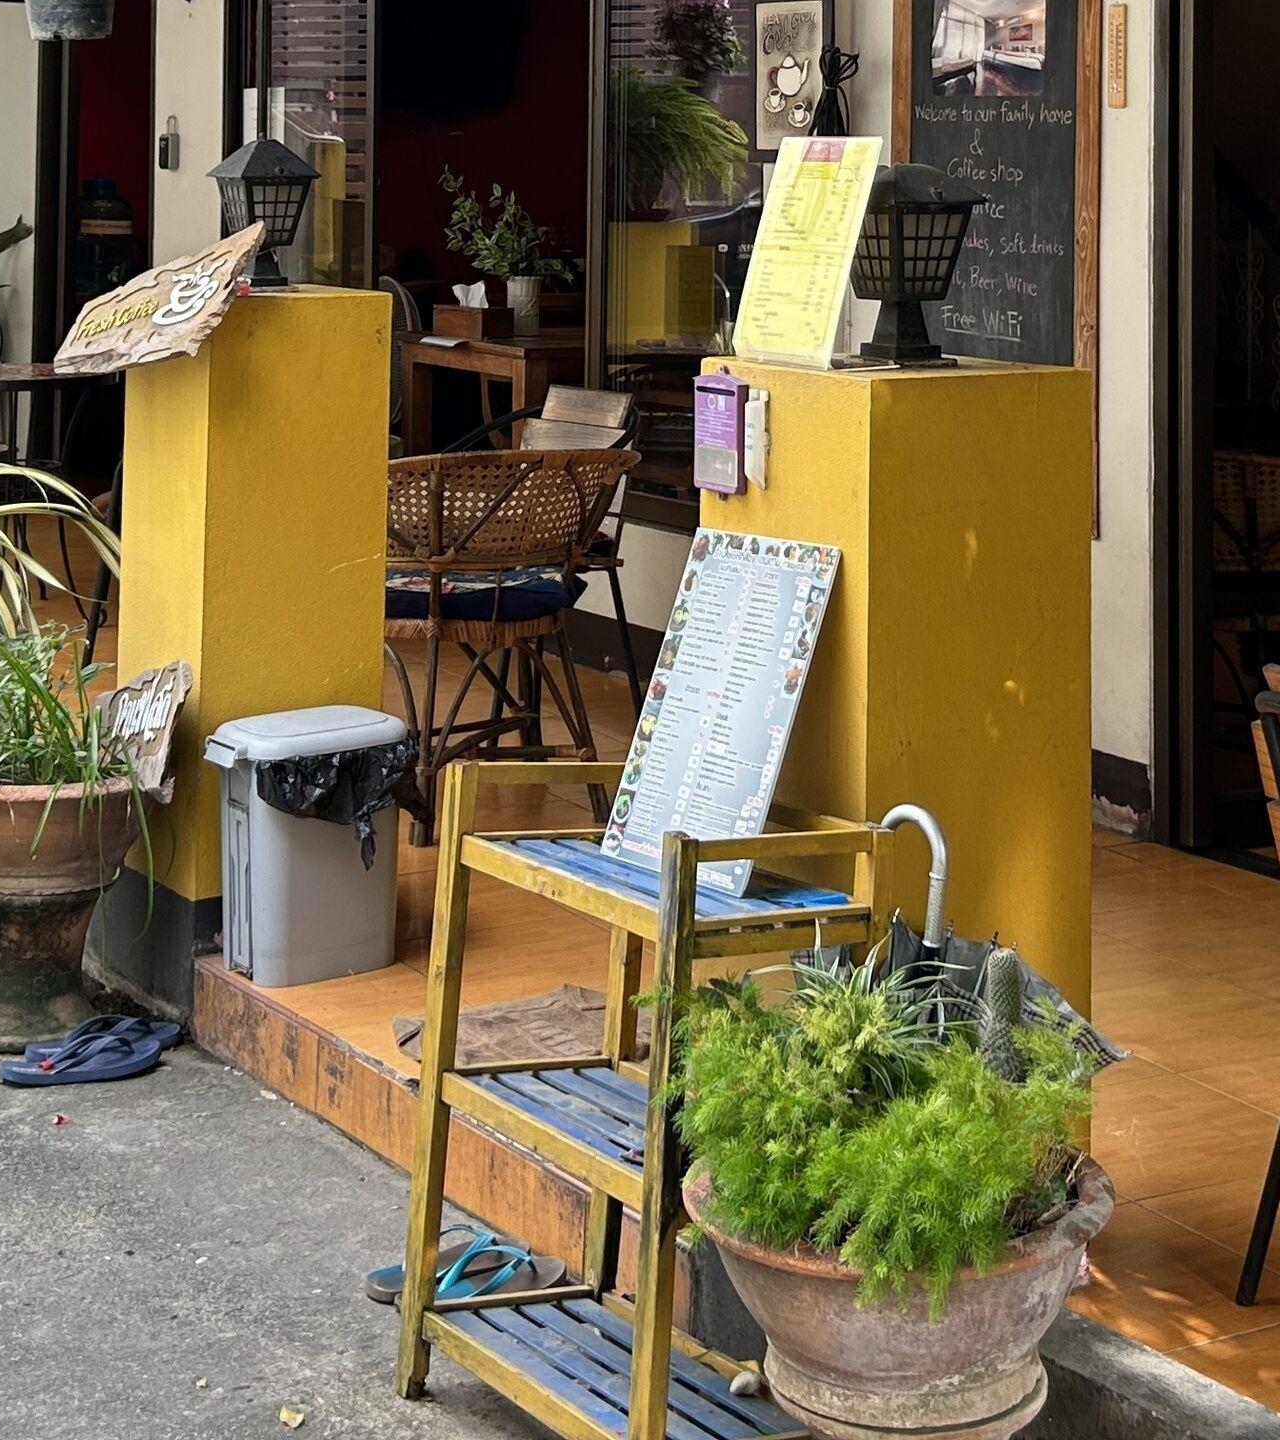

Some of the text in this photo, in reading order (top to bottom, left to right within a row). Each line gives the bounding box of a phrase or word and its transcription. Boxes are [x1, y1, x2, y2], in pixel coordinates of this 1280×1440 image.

[914, 100, 1073, 130] Welcome to our family home
[969, 128, 984, 156] &
[946, 156, 1024, 187] Coffee shop
[972, 193, 1005, 218] offee
[1000, 232, 1027, 254] Soft
[1030, 233, 1065, 256] drinks
[968, 265, 1002, 296] Beer,
[1004, 272, 1038, 297] Wine
[77, 298, 159, 340] Fresh Coffee
[940, 305, 976, 329] Free
